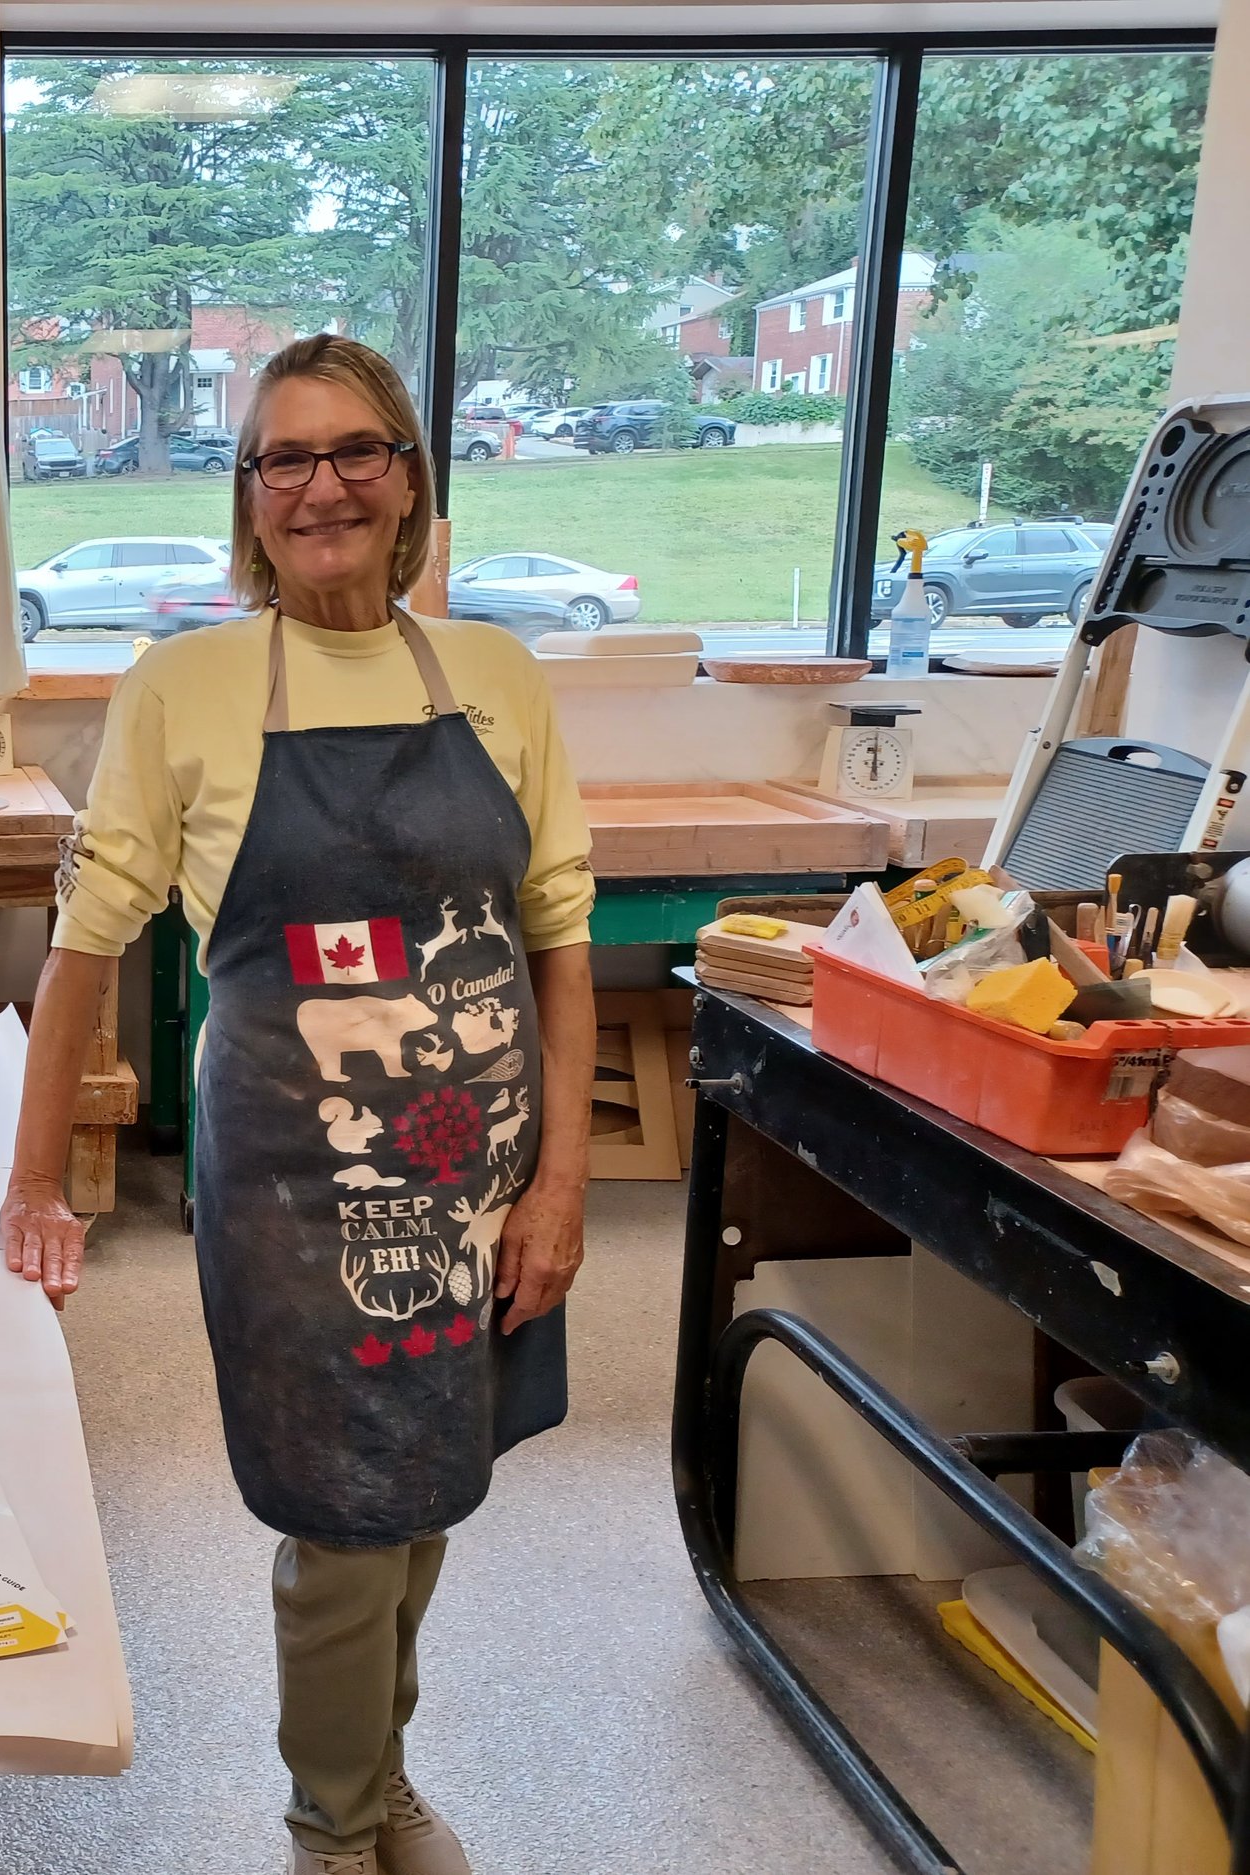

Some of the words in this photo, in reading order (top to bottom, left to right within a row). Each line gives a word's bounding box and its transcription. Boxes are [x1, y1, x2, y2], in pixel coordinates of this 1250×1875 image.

[462, 704, 495, 726] Tides
[427, 983, 446, 1005] O
[452, 961, 515, 1001] Canada!
[338, 1196, 434, 1220] KEEP
[370, 1245, 421, 1274] EH!
[1, 1576, 26, 1591] GUIDE
